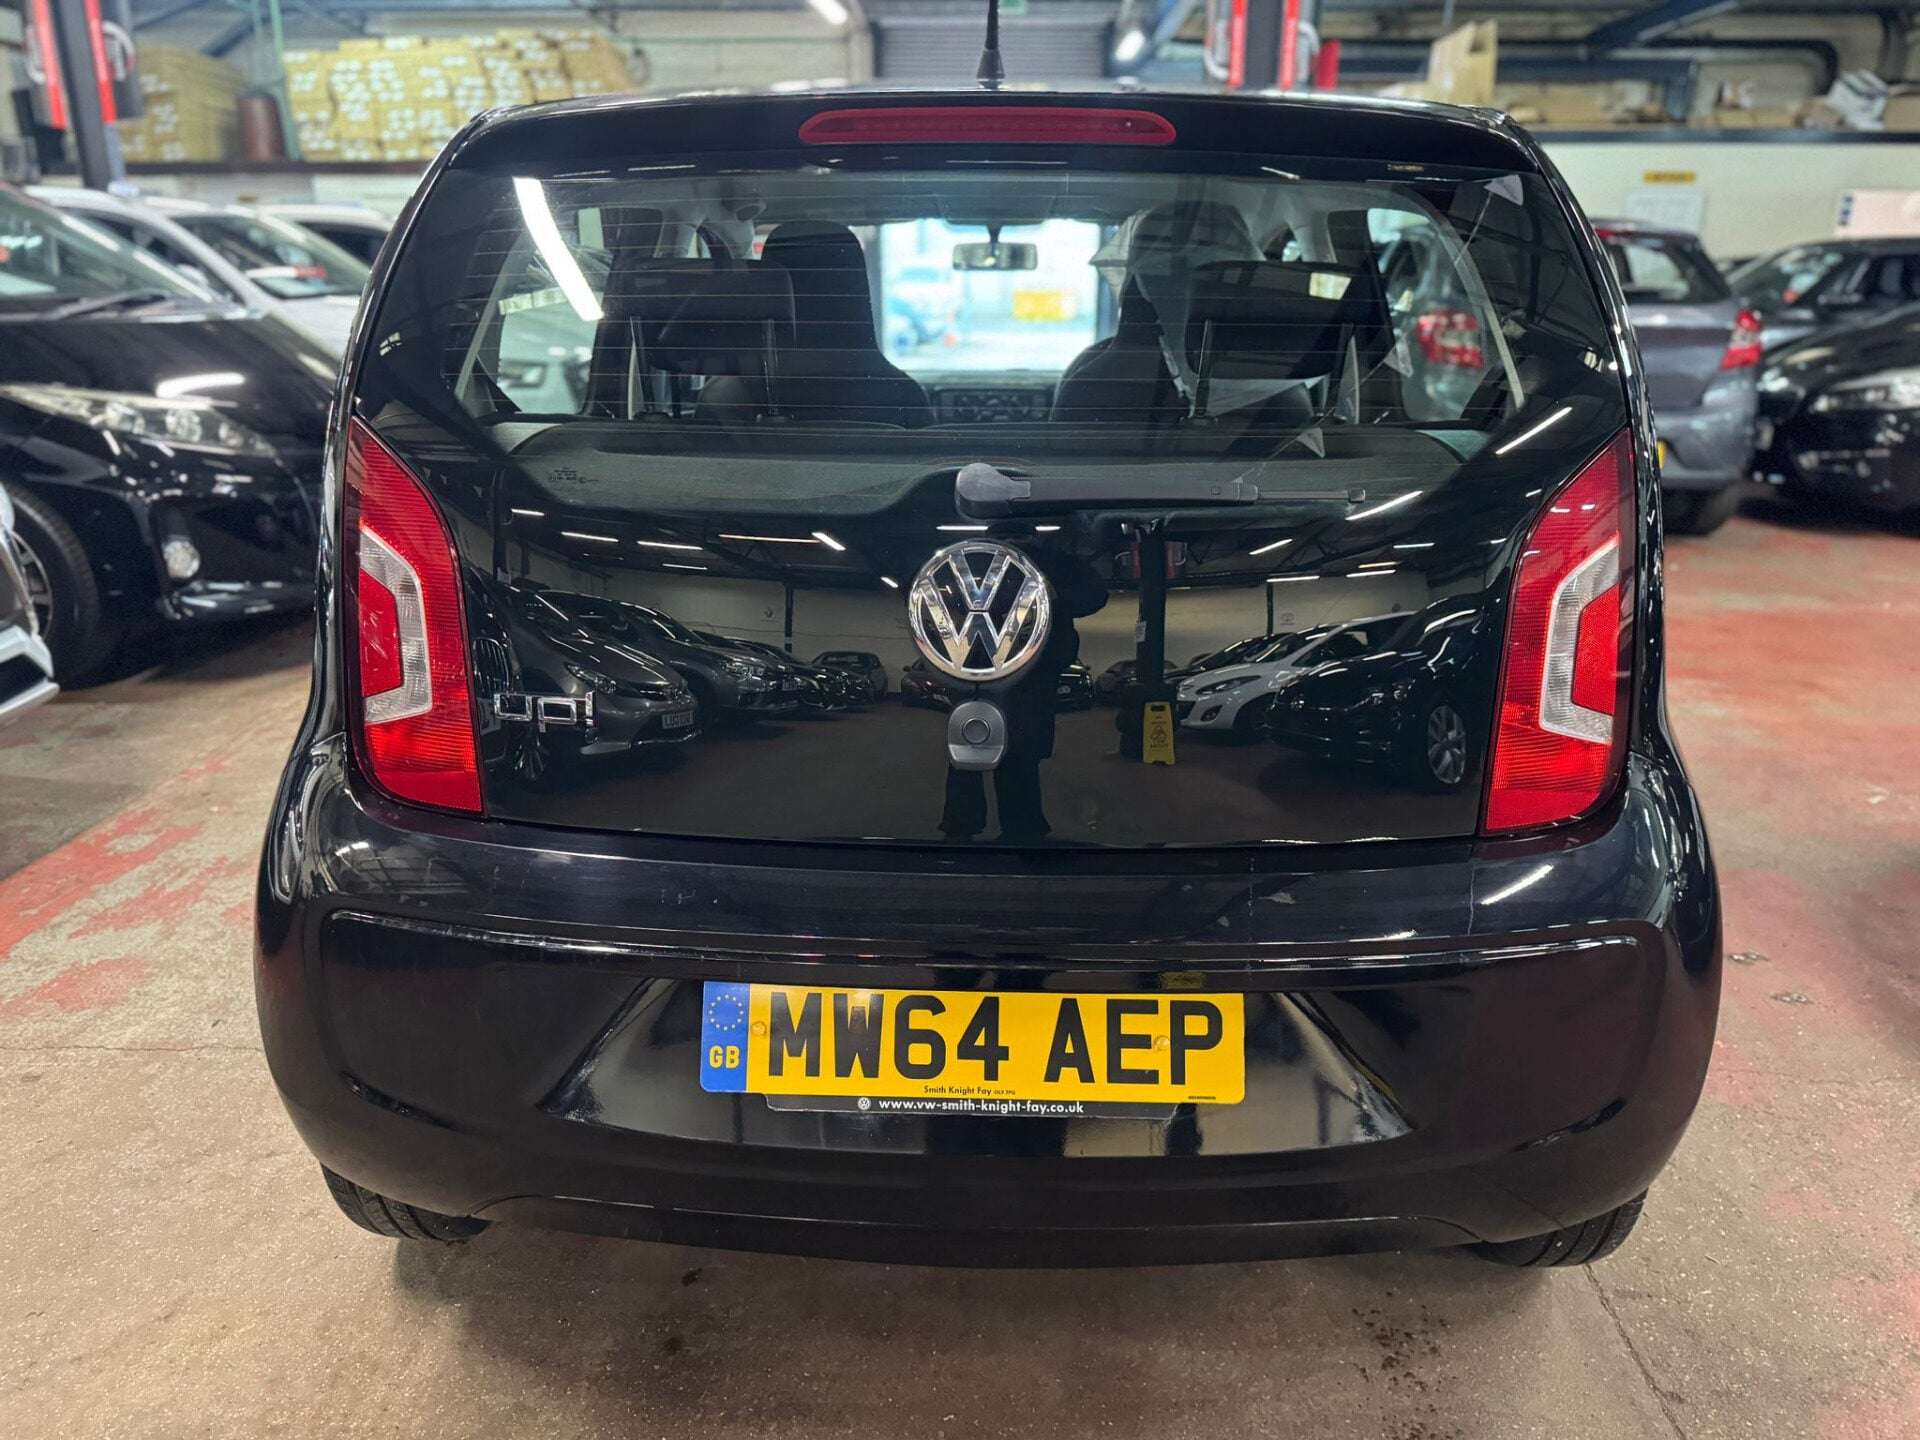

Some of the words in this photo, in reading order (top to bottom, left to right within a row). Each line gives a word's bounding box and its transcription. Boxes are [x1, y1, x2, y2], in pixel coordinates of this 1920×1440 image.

[911, 543, 1048, 680] VW
[769, 992, 1009, 1081] MW64
[1044, 998, 1223, 1085] AEP
[709, 1045, 740, 1069] GB
[924, 1085, 946, 1095] Smith
[948, 1086, 975, 1096] Knight
[977, 1086, 992, 1096] Fay
[879, 1099, 1084, 1114] www.vw-smith-knight-fay.co.uk
